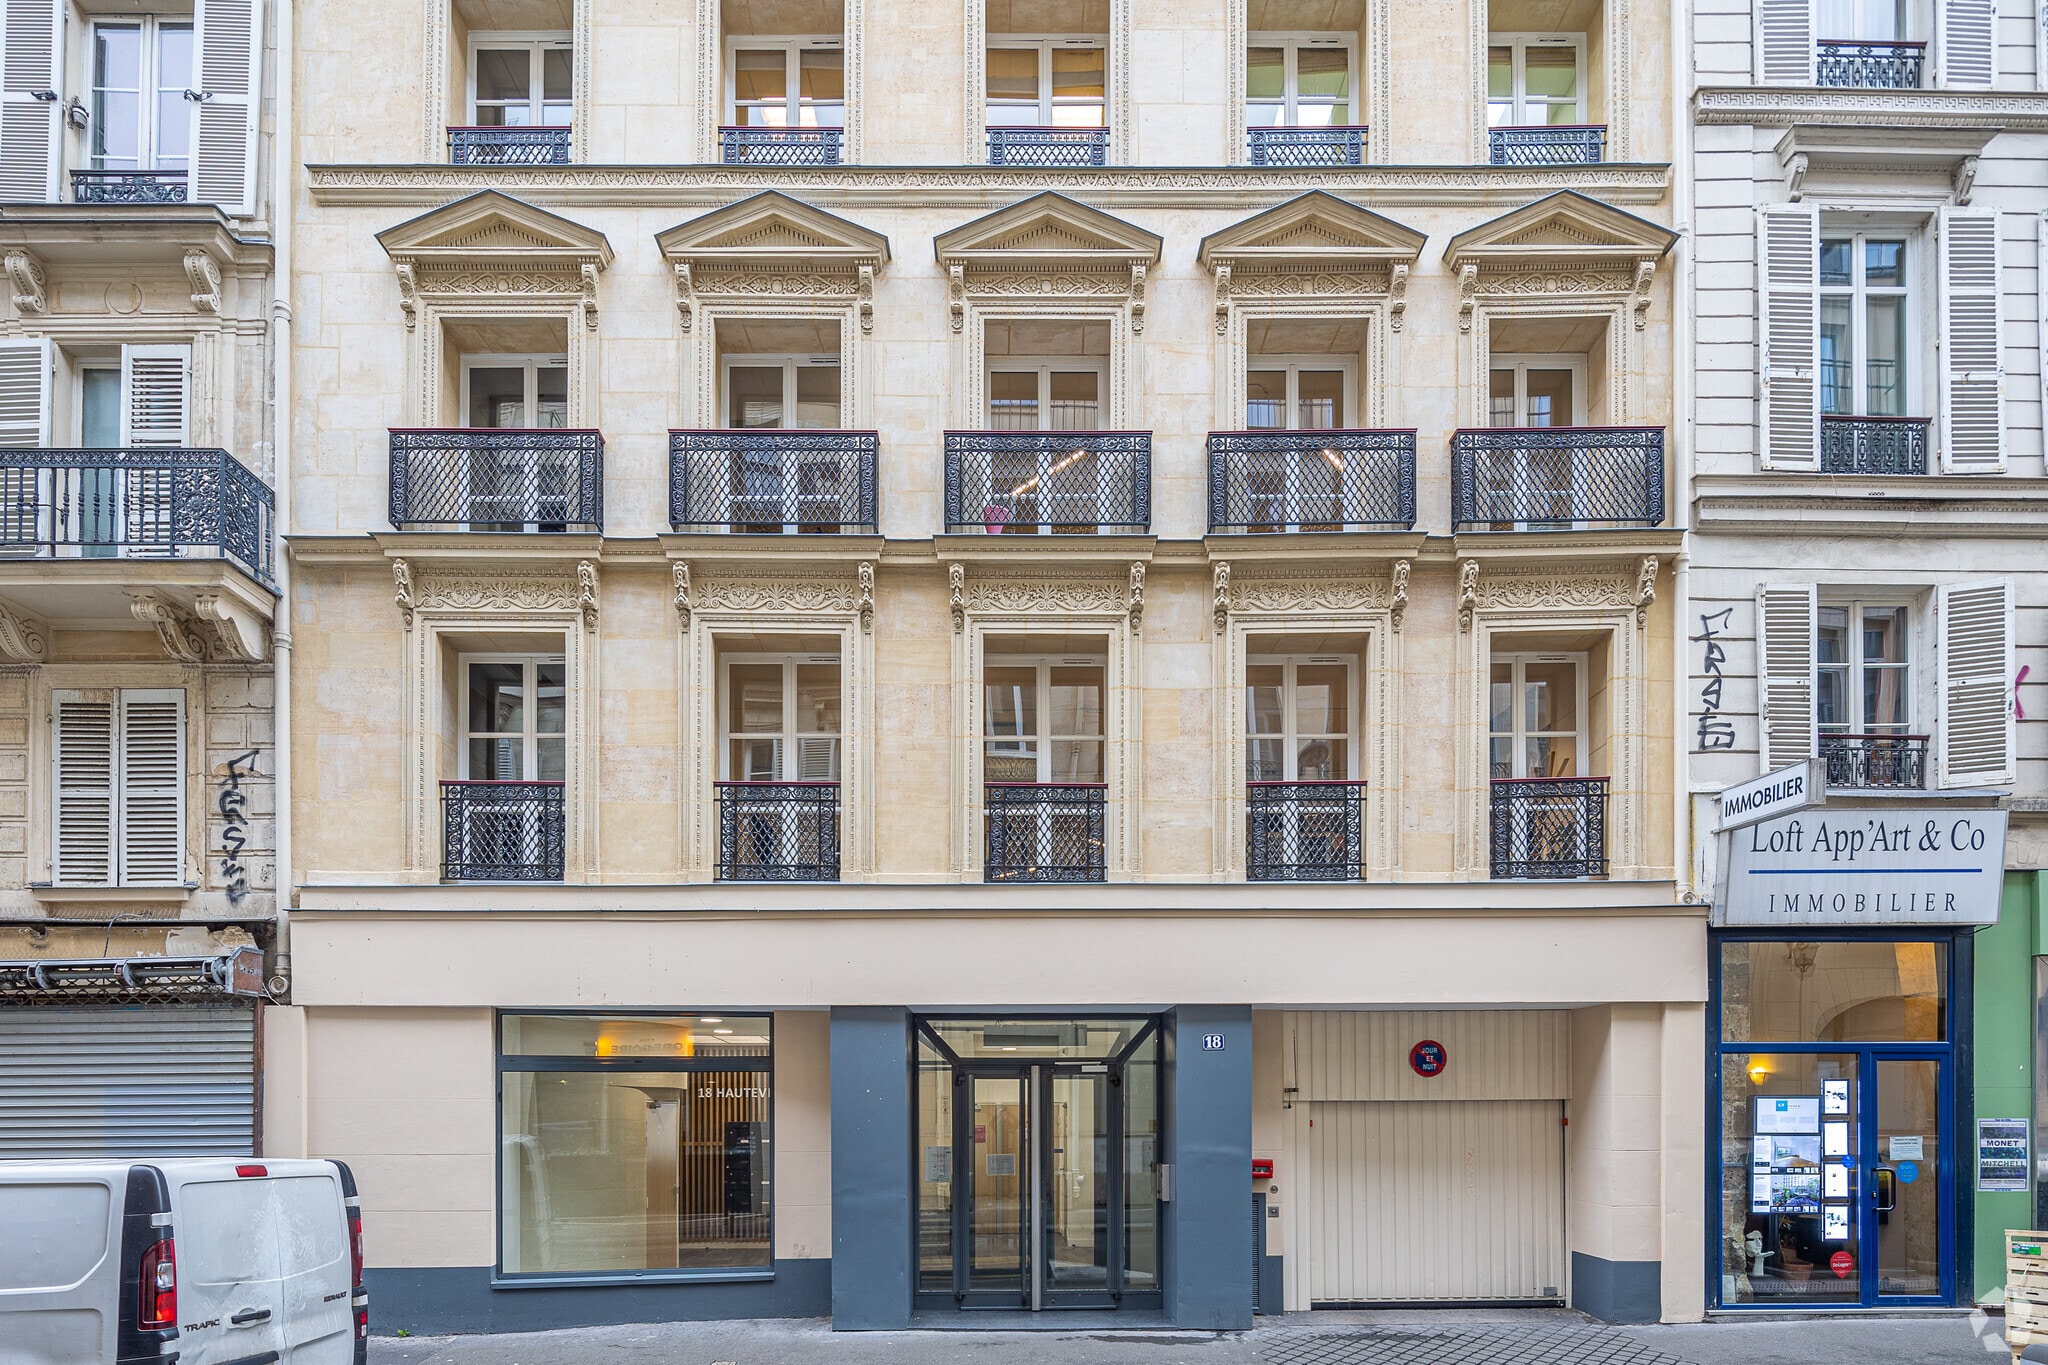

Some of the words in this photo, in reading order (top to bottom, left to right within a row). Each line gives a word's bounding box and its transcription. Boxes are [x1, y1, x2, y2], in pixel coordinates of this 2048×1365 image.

[1724, 776, 1804, 818] IMMOBILIER
[1750, 820, 1804, 853] Loft
[1918, 819, 1942, 851] &
[1950, 819, 1985, 851] Co
[1768, 893, 1956, 913] IMMOBILIER
[1205, 1036, 1221, 1048] 18
[698, 1088, 713, 1098] 18
[323, 1290, 348, 1303] RENAULT
[184, 1318, 220, 1332] TRAFIC
